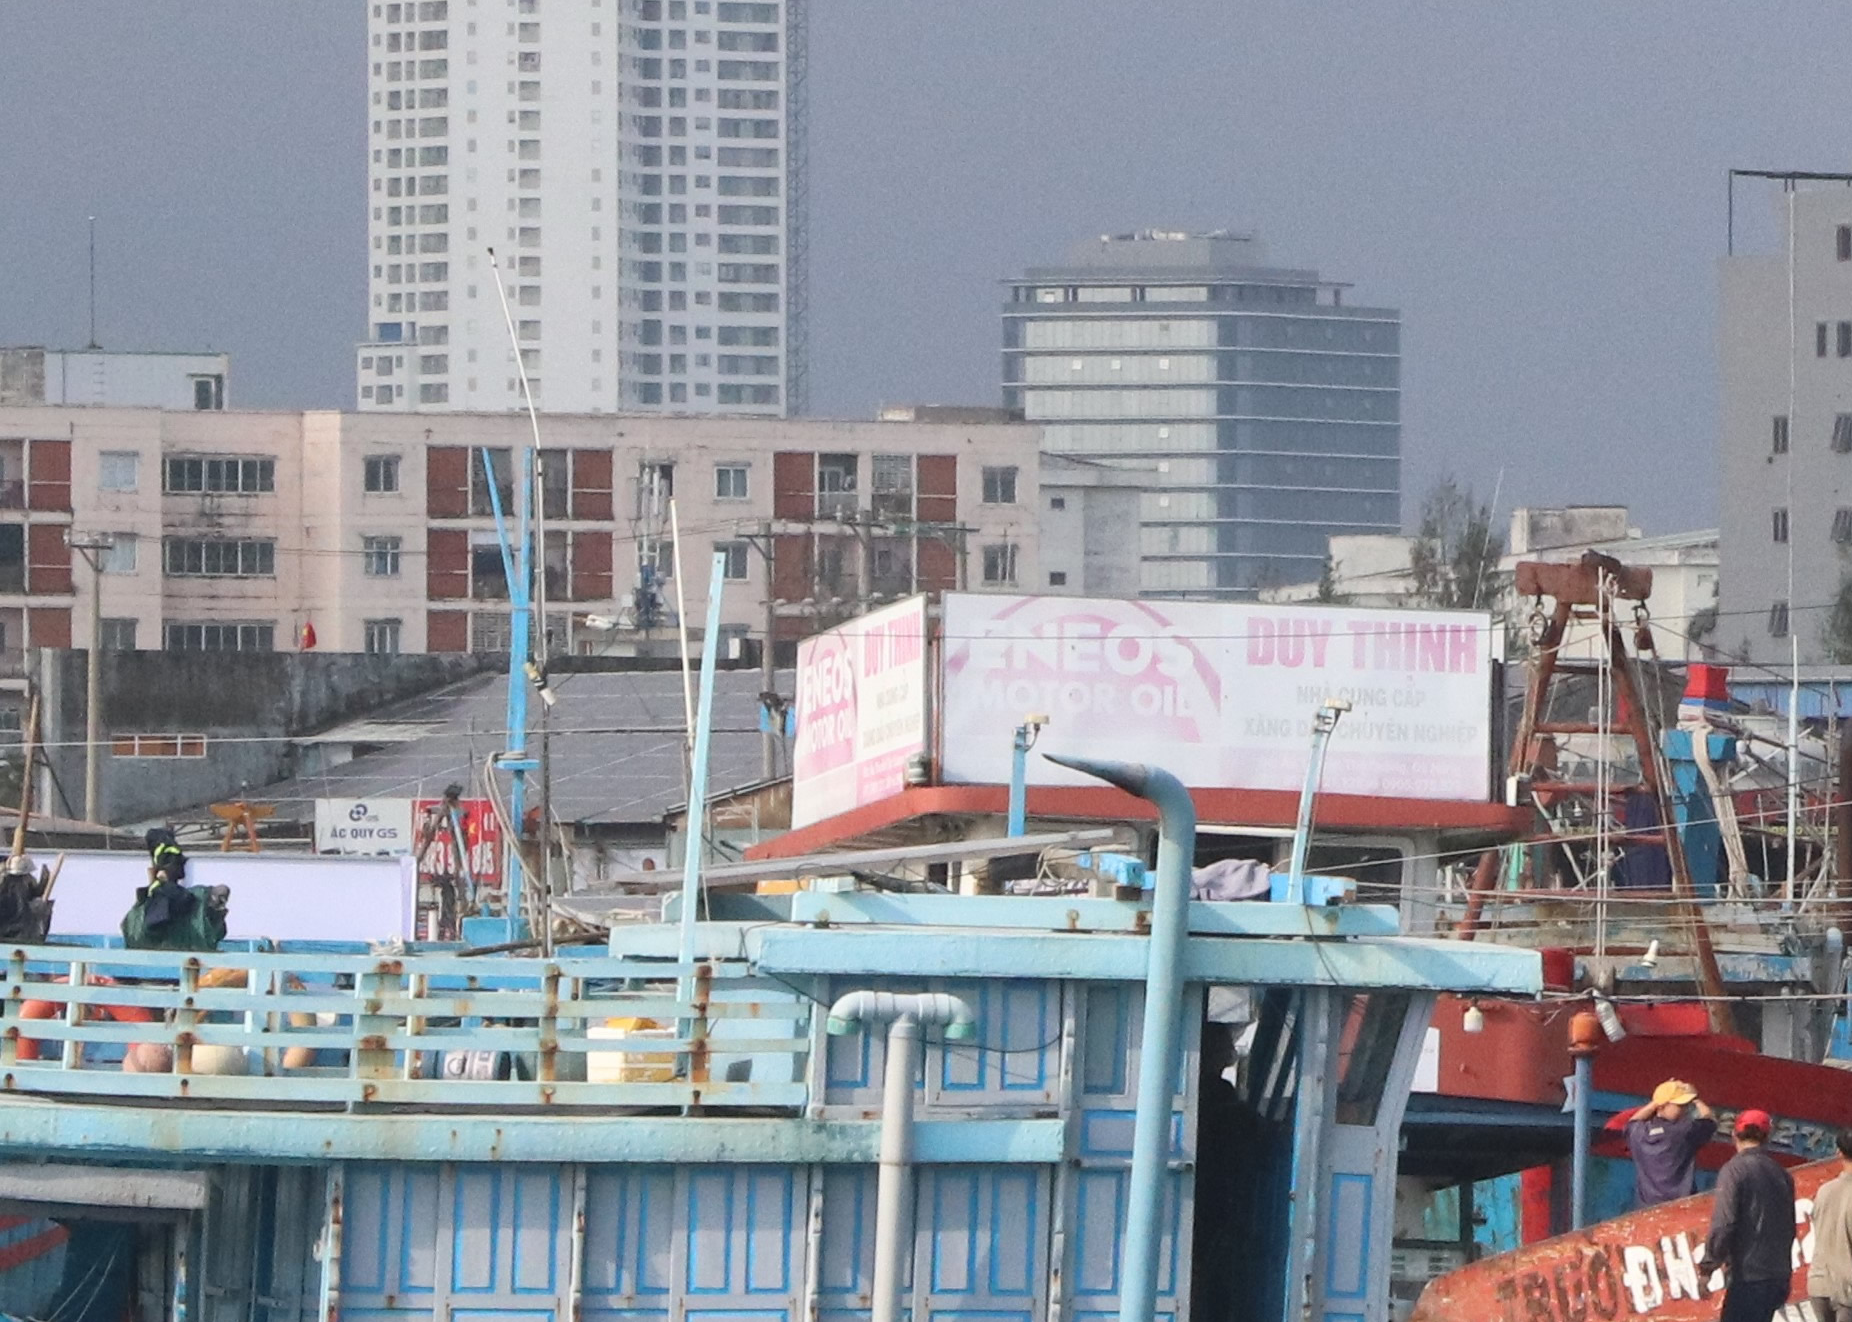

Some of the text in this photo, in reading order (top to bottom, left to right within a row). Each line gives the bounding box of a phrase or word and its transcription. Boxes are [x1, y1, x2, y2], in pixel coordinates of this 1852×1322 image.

[969, 620, 1194, 678] ENEOS
[1246, 616, 1332, 668] DUY
[972, 678, 1197, 718] MOTOR OIL
[351, 827, 374, 839] QUY
[376, 827, 398, 839] GS
